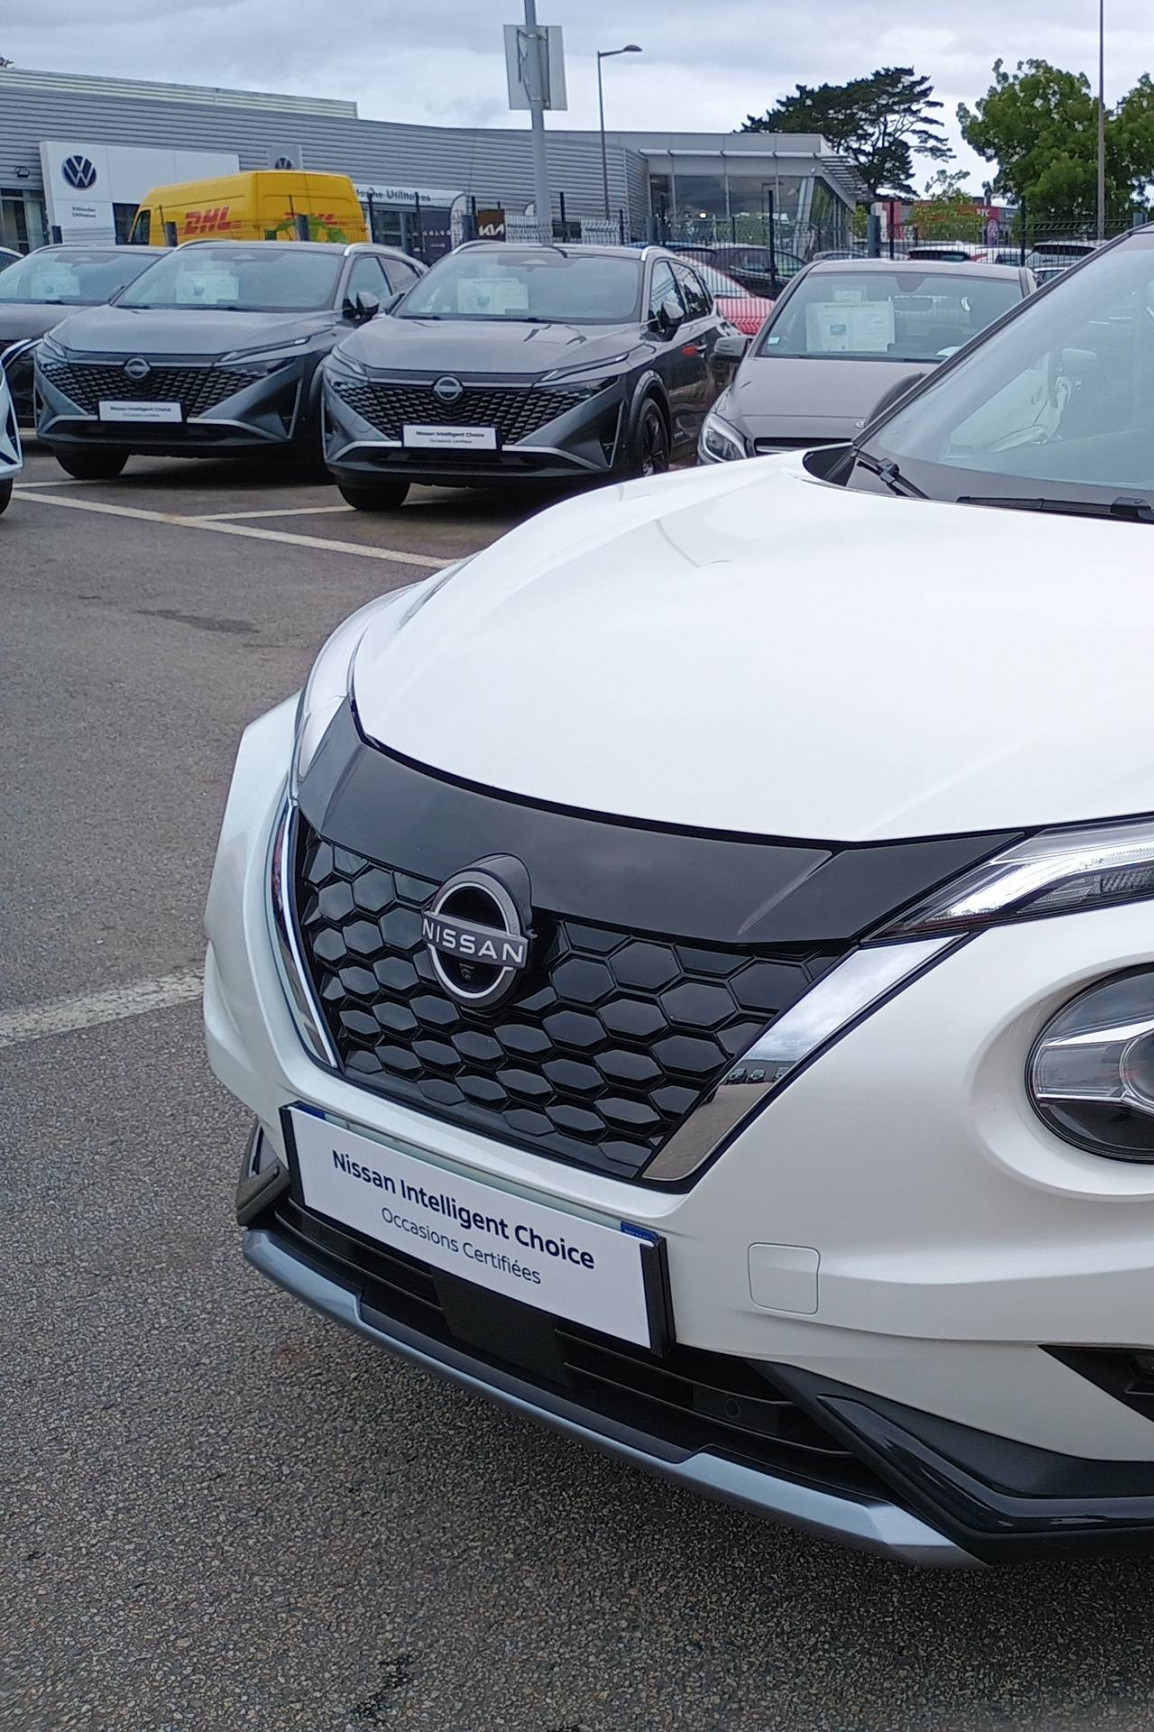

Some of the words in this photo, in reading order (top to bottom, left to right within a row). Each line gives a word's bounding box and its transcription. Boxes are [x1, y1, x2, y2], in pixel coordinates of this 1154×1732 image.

[184, 206, 231, 235] DHL
[422, 918, 524, 963] NISSAN
[332, 1150, 396, 1194] Nissan
[400, 1179, 510, 1240] Intelligent
[514, 1225, 595, 1270] Choice
[381, 1207, 459, 1253] Occasions
[462, 1242, 542, 1285] Certifiées
